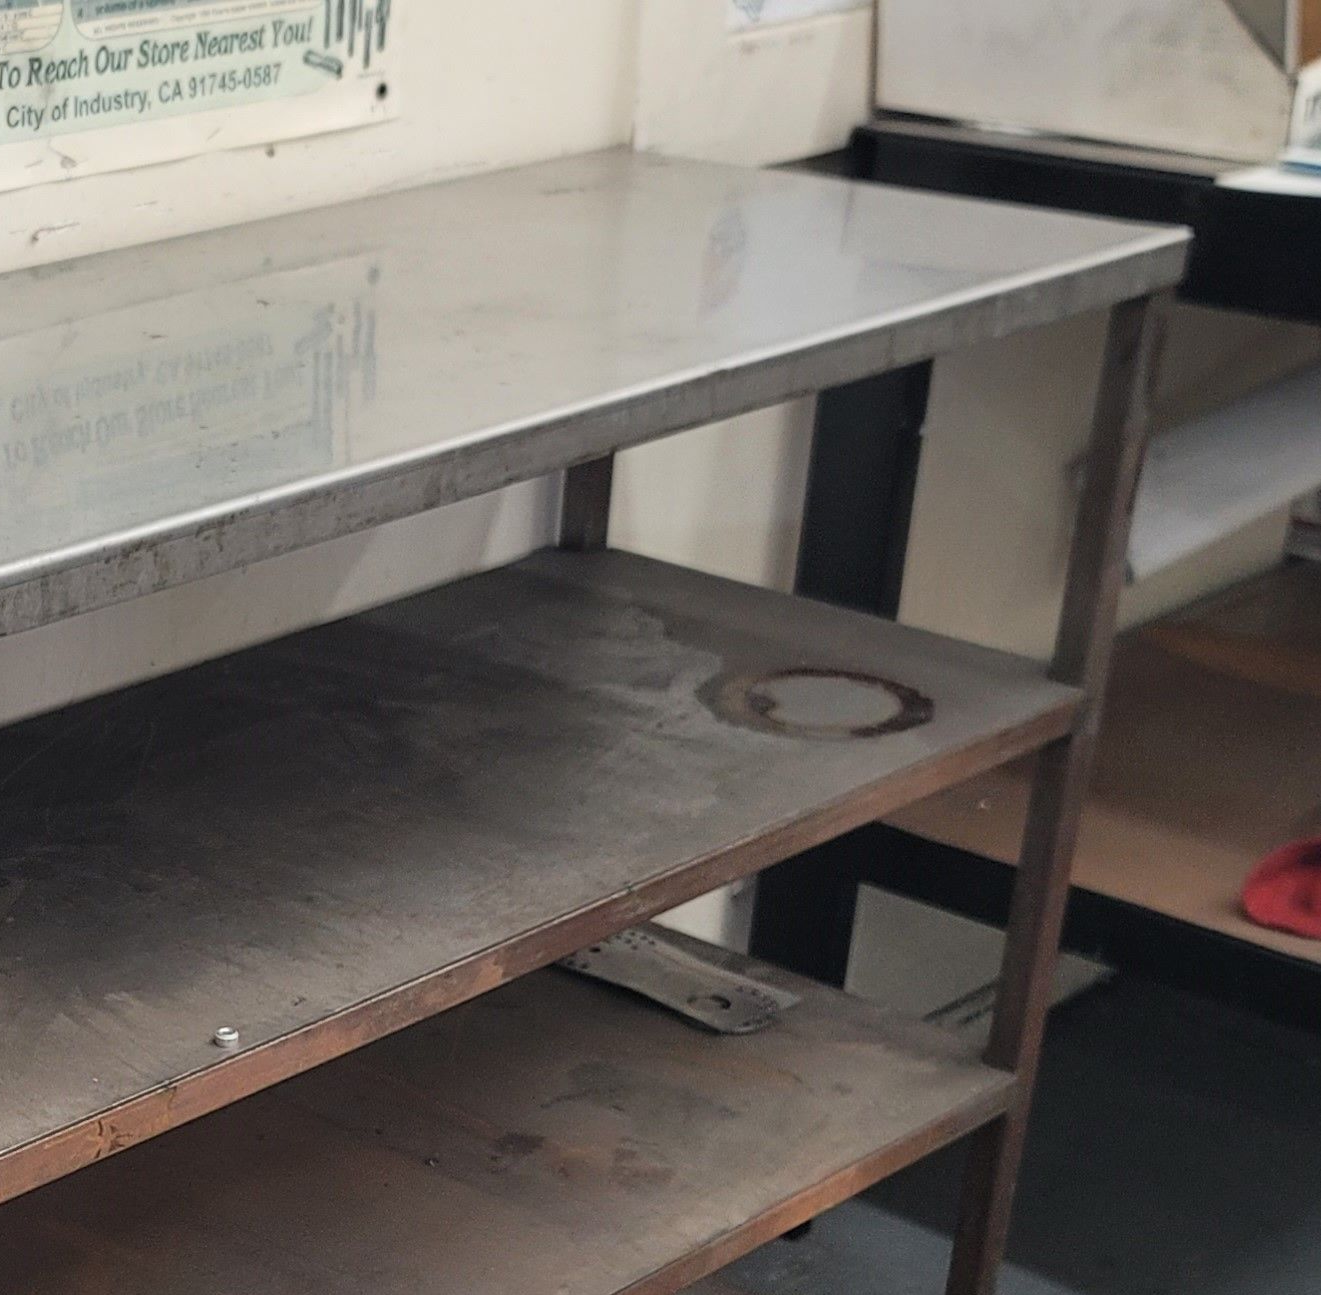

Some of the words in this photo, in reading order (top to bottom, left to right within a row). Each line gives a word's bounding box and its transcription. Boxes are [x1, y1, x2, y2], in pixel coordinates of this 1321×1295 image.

[26, 46, 89, 88] Reach
[94, 45, 132, 75] Our
[137, 40, 189, 68] Store
[193, 24, 265, 60] Nearest
[271, 16, 313, 46] You!
[5, 103, 44, 132] City
[50, 97, 69, 122] of
[73, 86, 151, 118] Industry,
[159, 80, 183, 104] CA
[188, 63, 282, 98] 91745-0587
